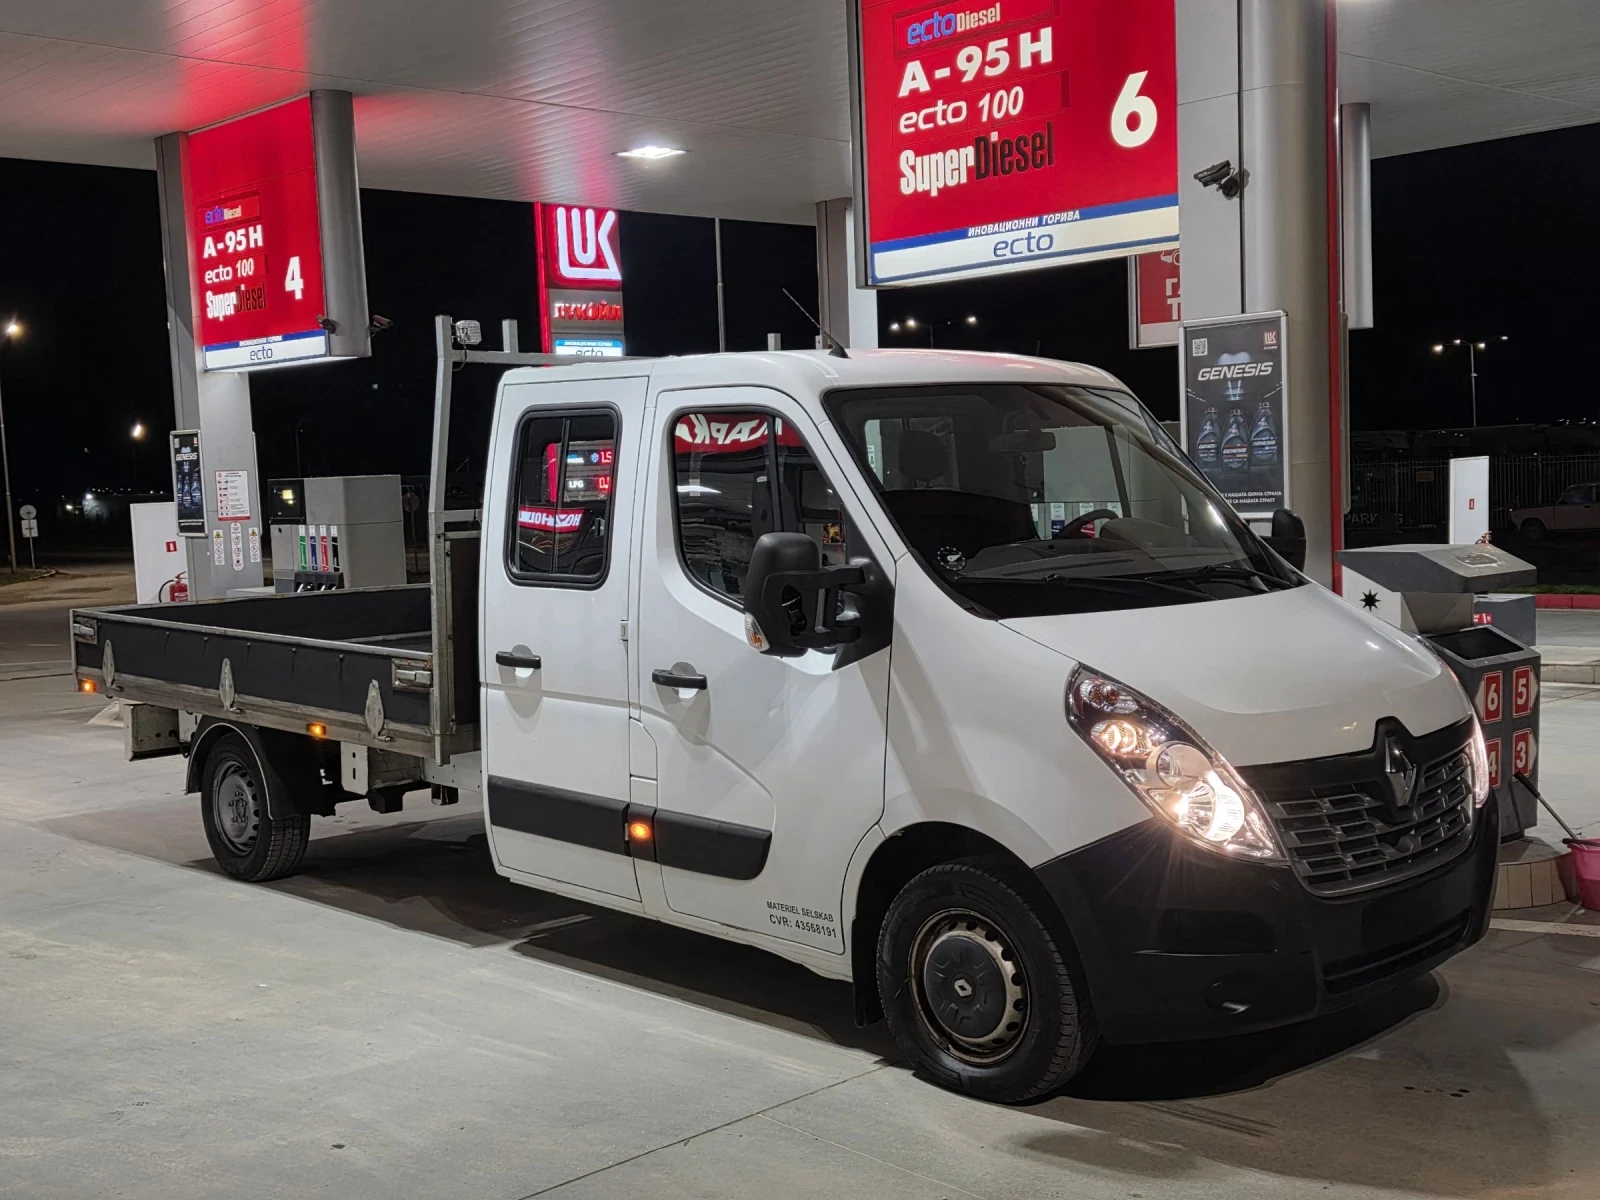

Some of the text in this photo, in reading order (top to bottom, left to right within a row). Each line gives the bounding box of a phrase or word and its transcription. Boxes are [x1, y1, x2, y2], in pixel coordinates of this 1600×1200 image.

[900, 86, 1024, 134] ecto 100
[1110, 70, 1158, 148] 6
[968, 210, 1080, 237] ИНОВАЦИОННИ ГОРИВА
[993, 231, 1054, 258] ecto
[205, 257, 254, 284] ecto 100
[285, 255, 304, 300] 4
[249, 345, 273, 361] ecto
[1197, 362, 1274, 381] GENESIS
[1487, 682, 1498, 711] 6
[1516, 677, 1527, 705] 5
[1488, 751, 1498, 777] 4
[1516, 741, 1526, 768] 3
[767, 901, 834, 922] MATERIEL SELSKAB
[769, 914, 837, 938] CVR: 43568191
